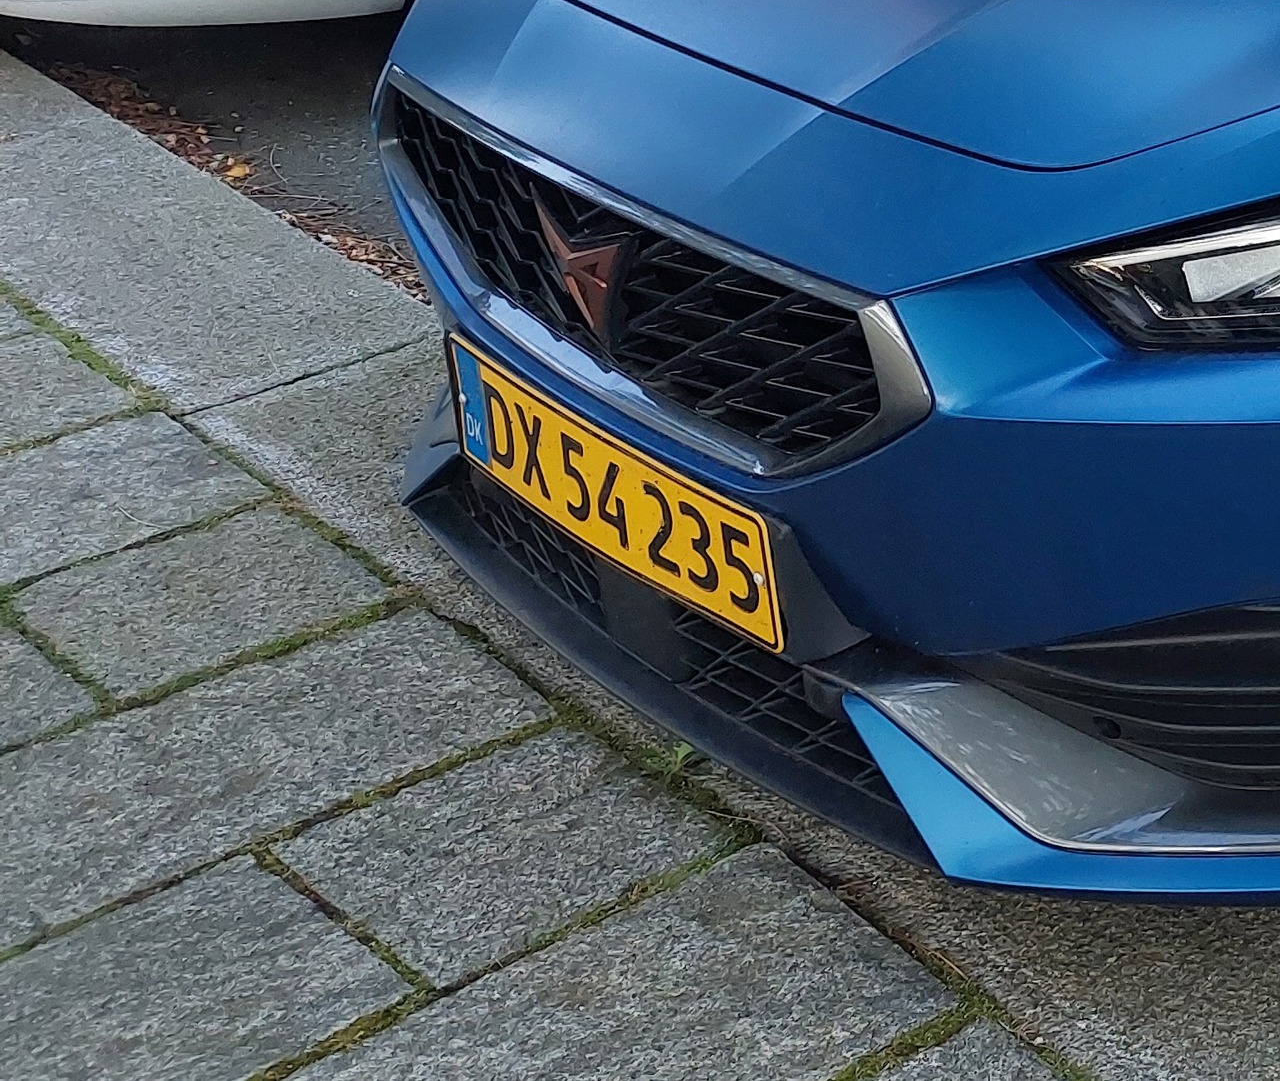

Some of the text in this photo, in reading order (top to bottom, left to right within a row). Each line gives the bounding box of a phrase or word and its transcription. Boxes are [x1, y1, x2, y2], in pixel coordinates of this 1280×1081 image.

[465, 383, 761, 614] DK DX 54 235
